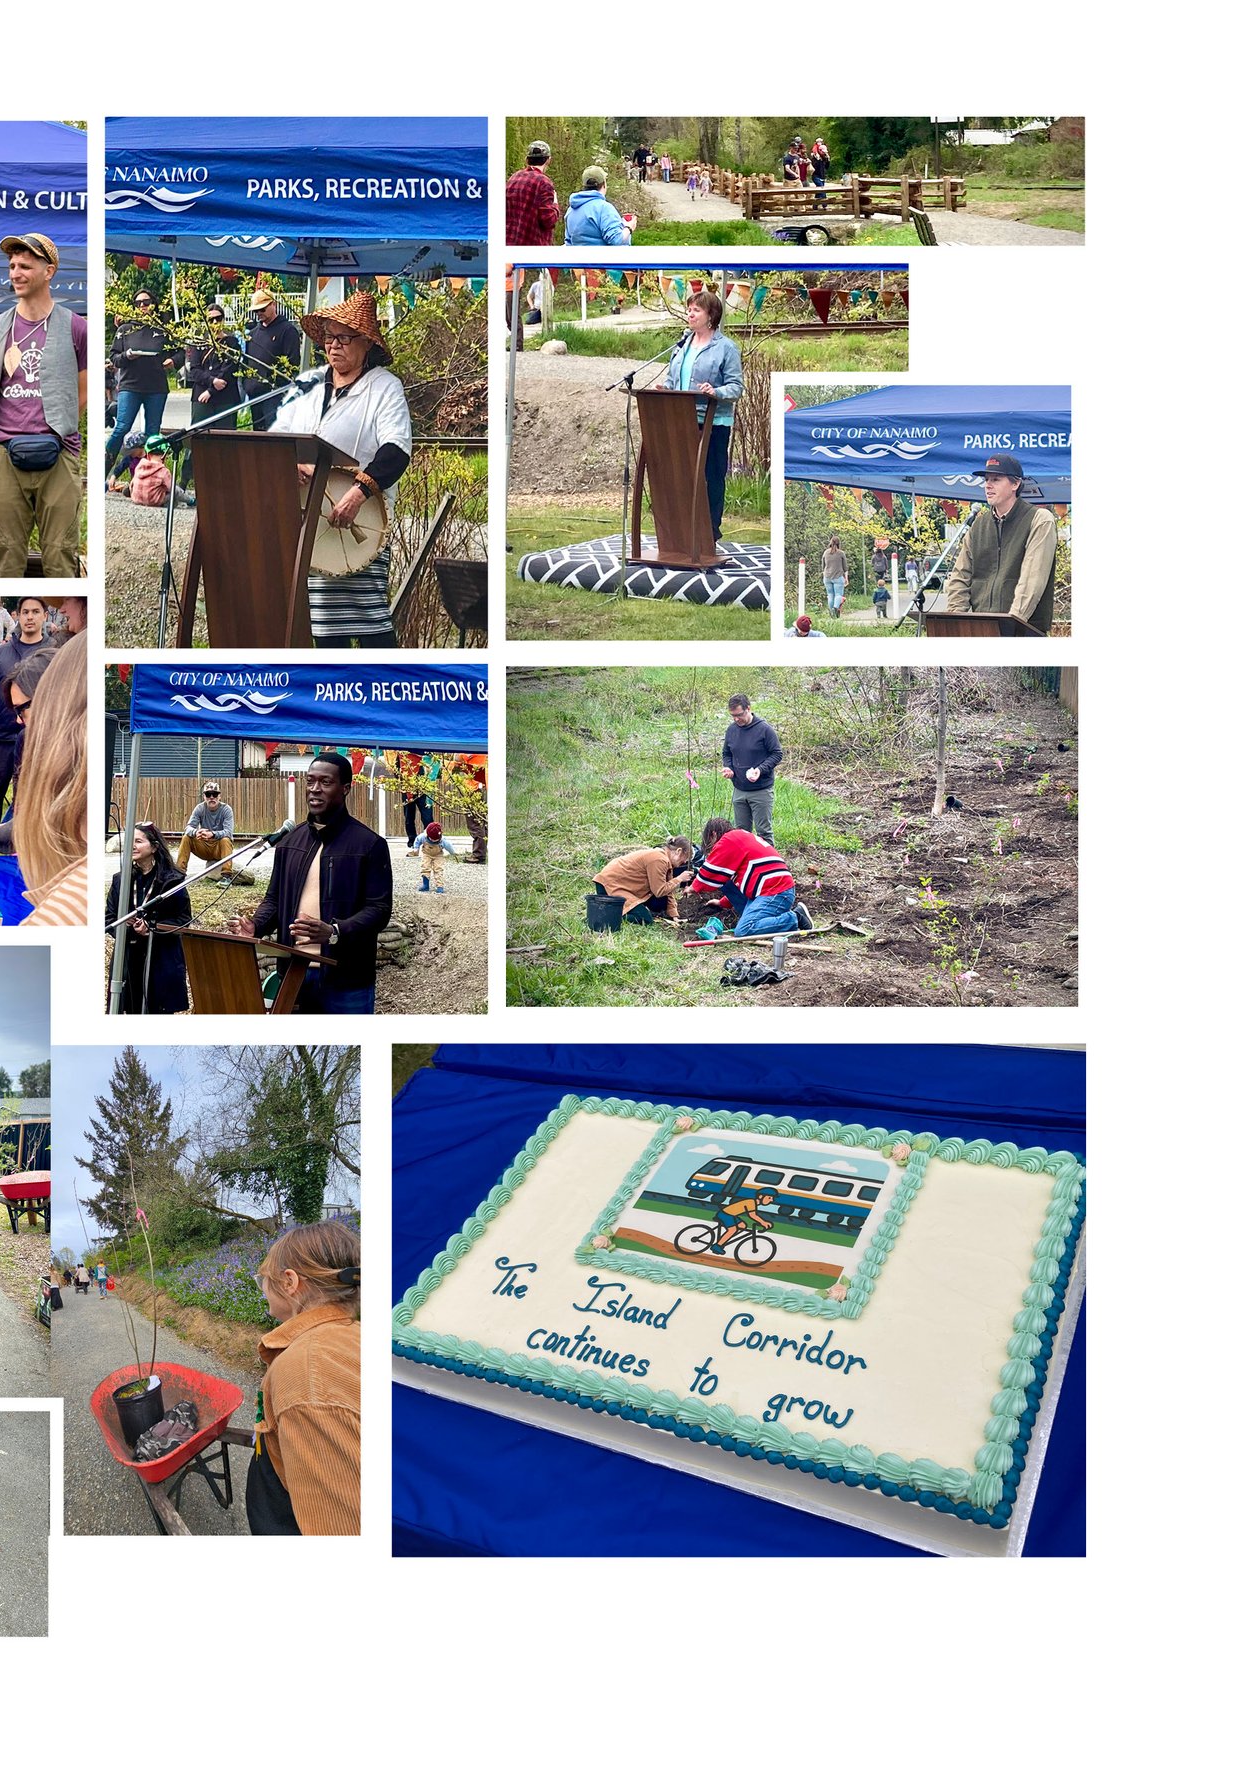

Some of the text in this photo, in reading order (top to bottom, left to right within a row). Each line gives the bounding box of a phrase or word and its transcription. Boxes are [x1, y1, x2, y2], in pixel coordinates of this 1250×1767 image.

[112, 166, 208, 183] NANAIMO
[246, 178, 482, 201] PARKS, RECREATION &
[12, 190, 29, 210] &
[811, 426, 938, 439] CITY OF NANAIMO
[963, 434, 1015, 450] PARKS,
[169, 671, 290, 687] CITY OF NANAIMO
[314, 681, 488, 704] PARKS, RECREATION &
[492, 1256, 868, 1375] The Island Corridor
[526, 1324, 855, 1430] continues to grow
